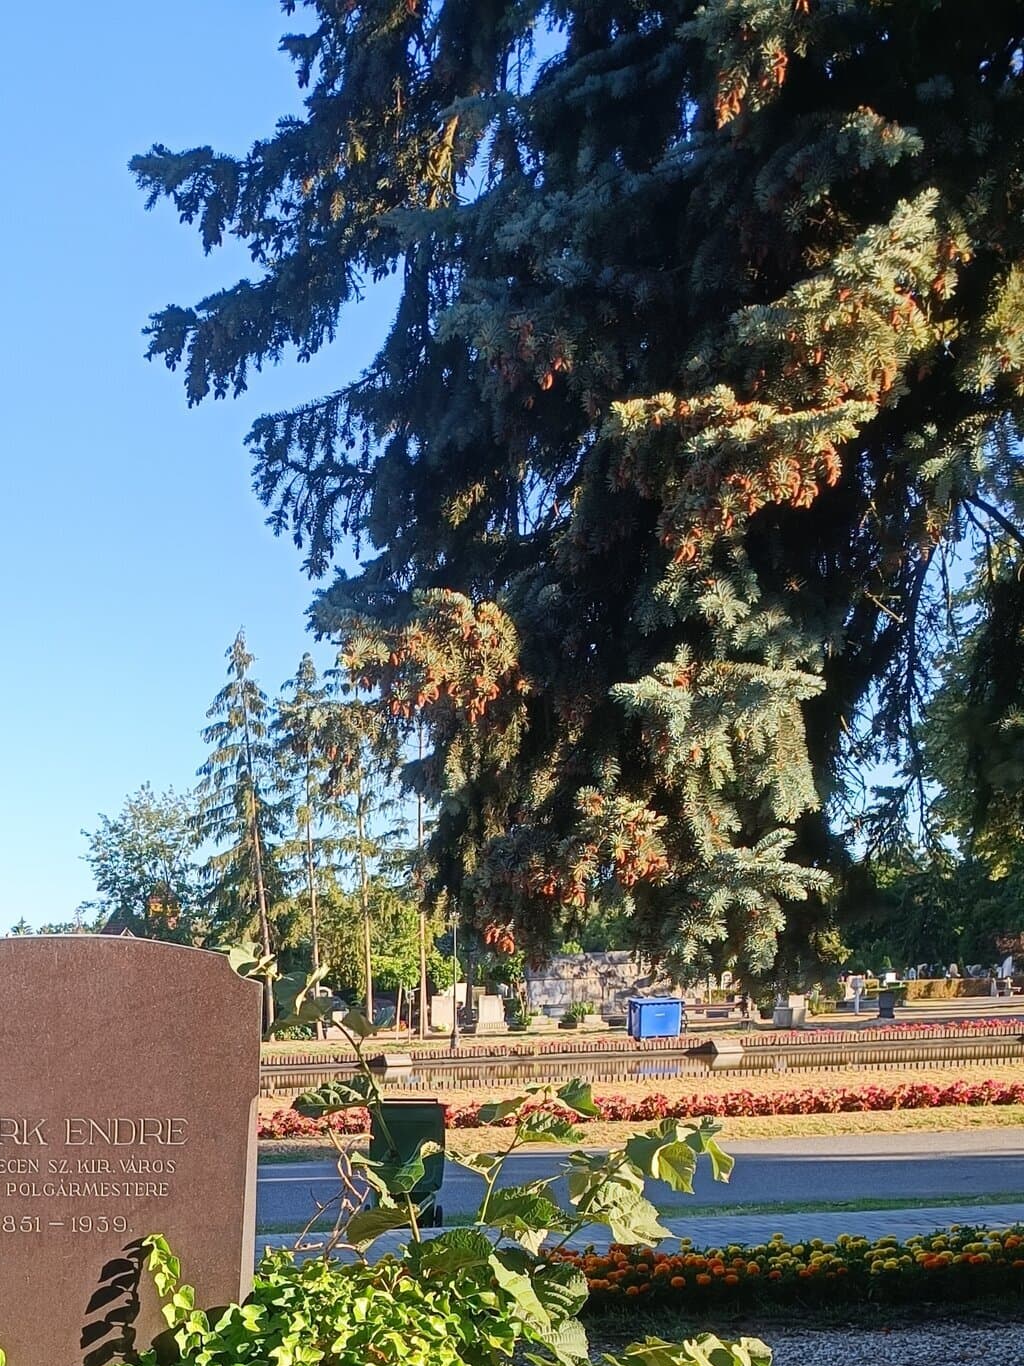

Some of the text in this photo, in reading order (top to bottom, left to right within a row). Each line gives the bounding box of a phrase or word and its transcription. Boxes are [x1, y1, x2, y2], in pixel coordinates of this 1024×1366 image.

[64, 1118, 190, 1146] ENDRE
[48, 1159, 73, 1174] SZ.
[77, 1159, 116, 1174] KIR.
[120, 1155, 177, 1174] VÁROS
[6, 1178, 170, 1197] POLGÁRMESTERE
[71, 1215, 134, 1233] 1939.
